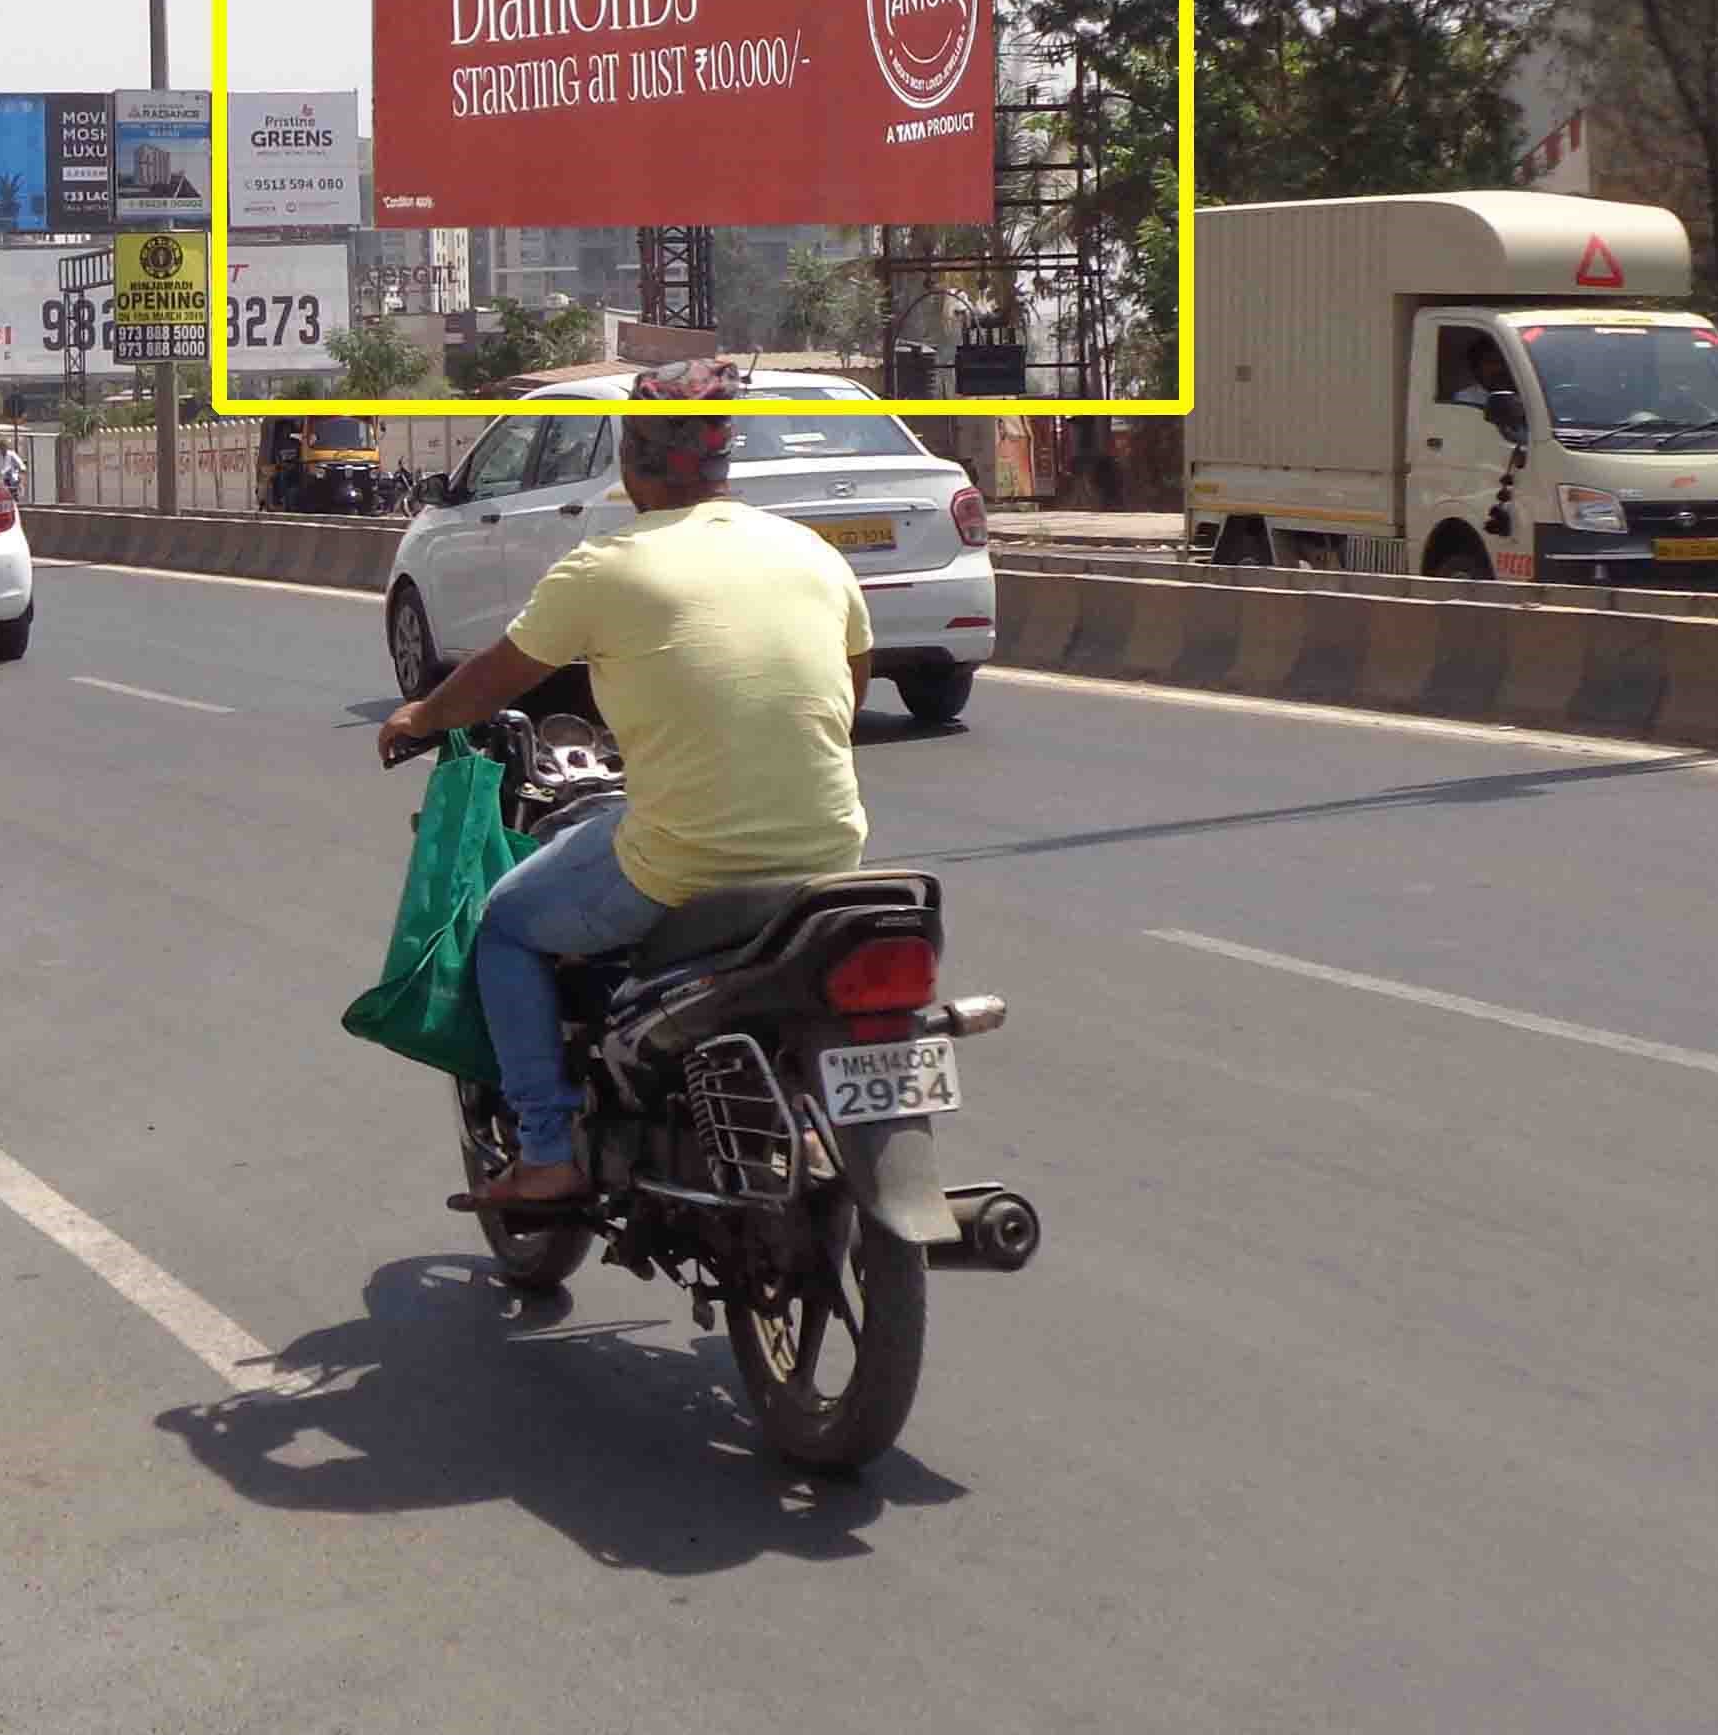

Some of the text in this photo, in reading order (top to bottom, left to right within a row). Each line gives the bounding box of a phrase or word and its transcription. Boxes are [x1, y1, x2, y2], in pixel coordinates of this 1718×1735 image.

[265, 115, 316, 128] Pristine
[886, 111, 975, 144] A TATA PRODUCT
[250, 130, 333, 148] GREENS
[117, 291, 205, 310] OPENING
[117, 325, 143, 341] 973
[173, 324, 205, 340] 5000
[117, 342, 143, 358] 973
[173, 340, 205, 356] 4000
[835, 1071, 954, 1116] 2954
